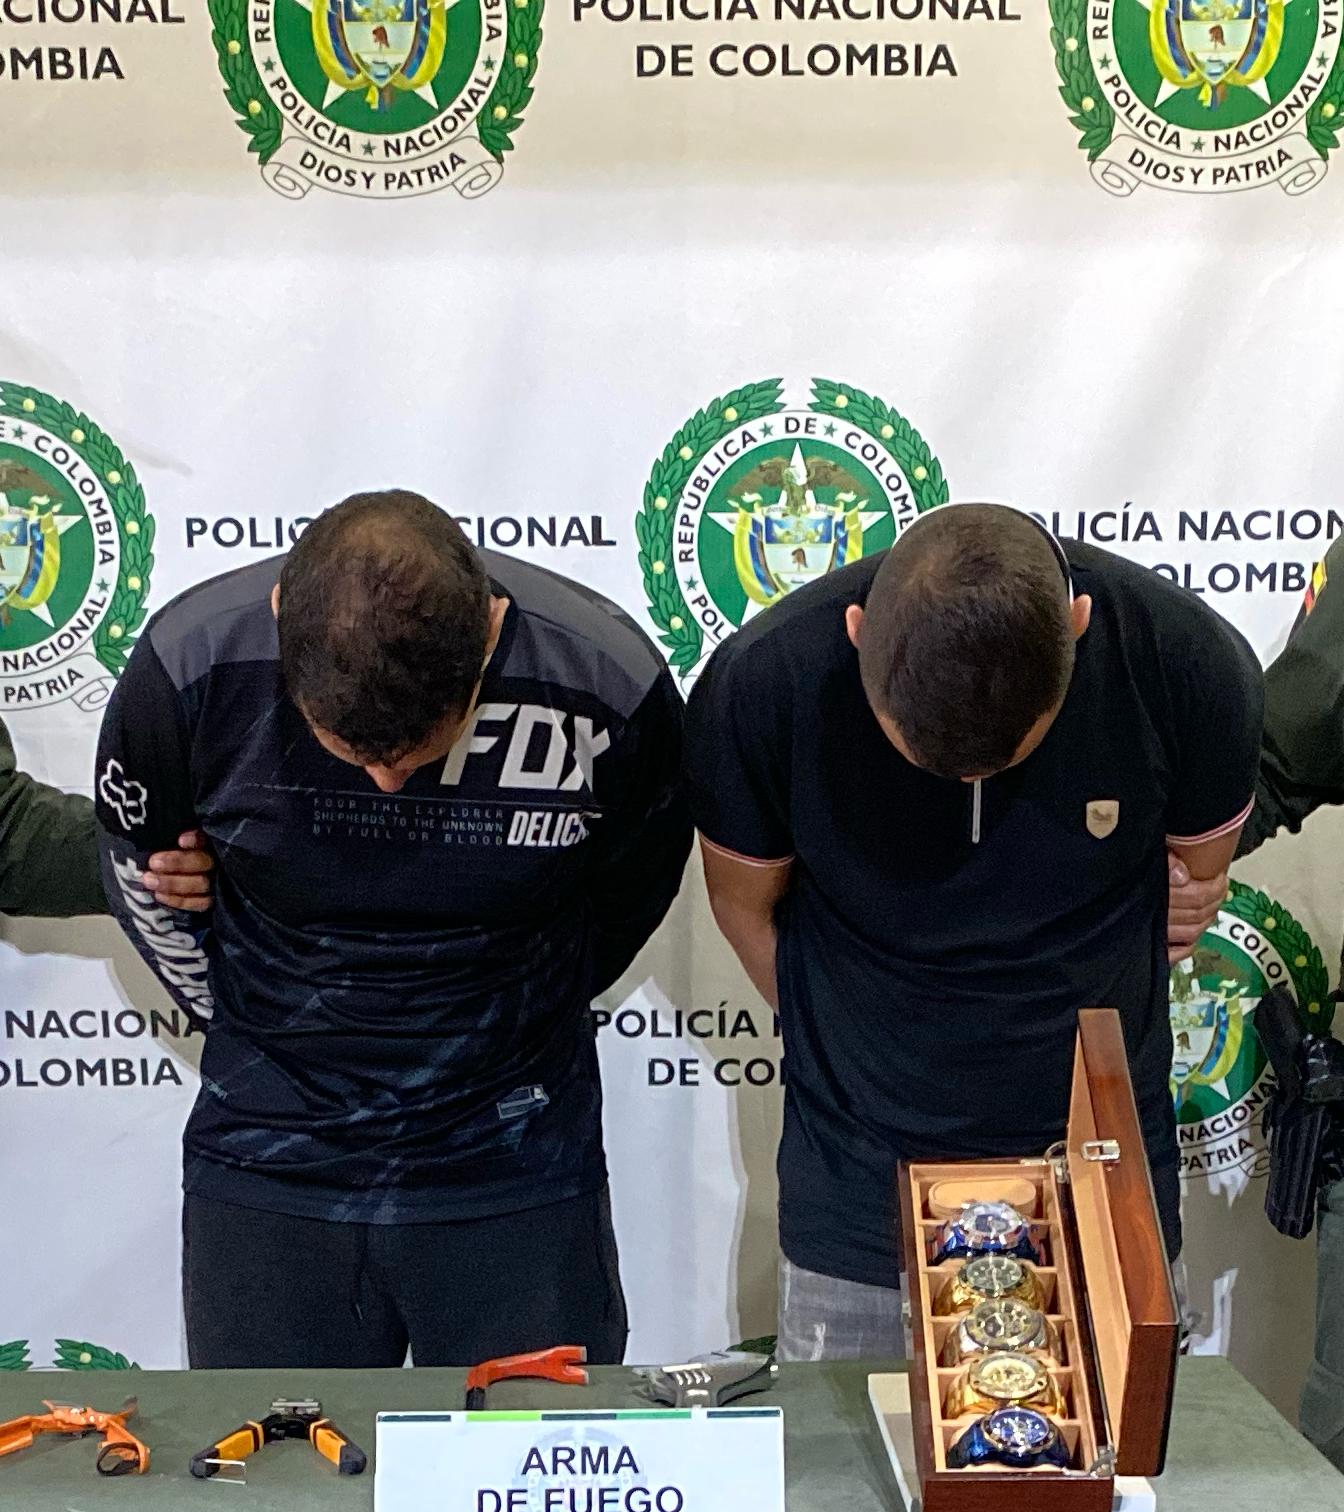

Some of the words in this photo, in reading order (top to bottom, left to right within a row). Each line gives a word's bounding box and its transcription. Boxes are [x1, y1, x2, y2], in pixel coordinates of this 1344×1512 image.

[636, 44, 694, 77] DE
[708, 43, 958, 78] COLOMBIA
[384, 75, 493, 158] NACIONAL
[1214, 71, 1325, 152] NACIONAL
[384, 152, 468, 190] PATRIA
[1211, 148, 1294, 185] PATRIA
[784, 416, 817, 434] DE
[34, 435, 115, 565] COLOMBIA
[185, 516, 315, 548] POLIC
[456, 515, 616, 548] IONAL
[1029, 502, 1163, 542] LICÍA
[1151, 562, 1318, 594] OLOMB
[2, 596, 107, 672] NACIONAL
[3, 667, 84, 703] PATRIA
[440, 703, 611, 793] FOX
[392, 818, 407, 828] TO
[414, 818, 436, 829] THE
[442, 820, 504, 833] UNKNOWN
[592, 1001, 759, 1038] POLICÍA
[648, 1058, 699, 1086] DE
[1177, 1137, 1254, 1172] PATRIA
[521, 1445, 640, 1475] ARMA
